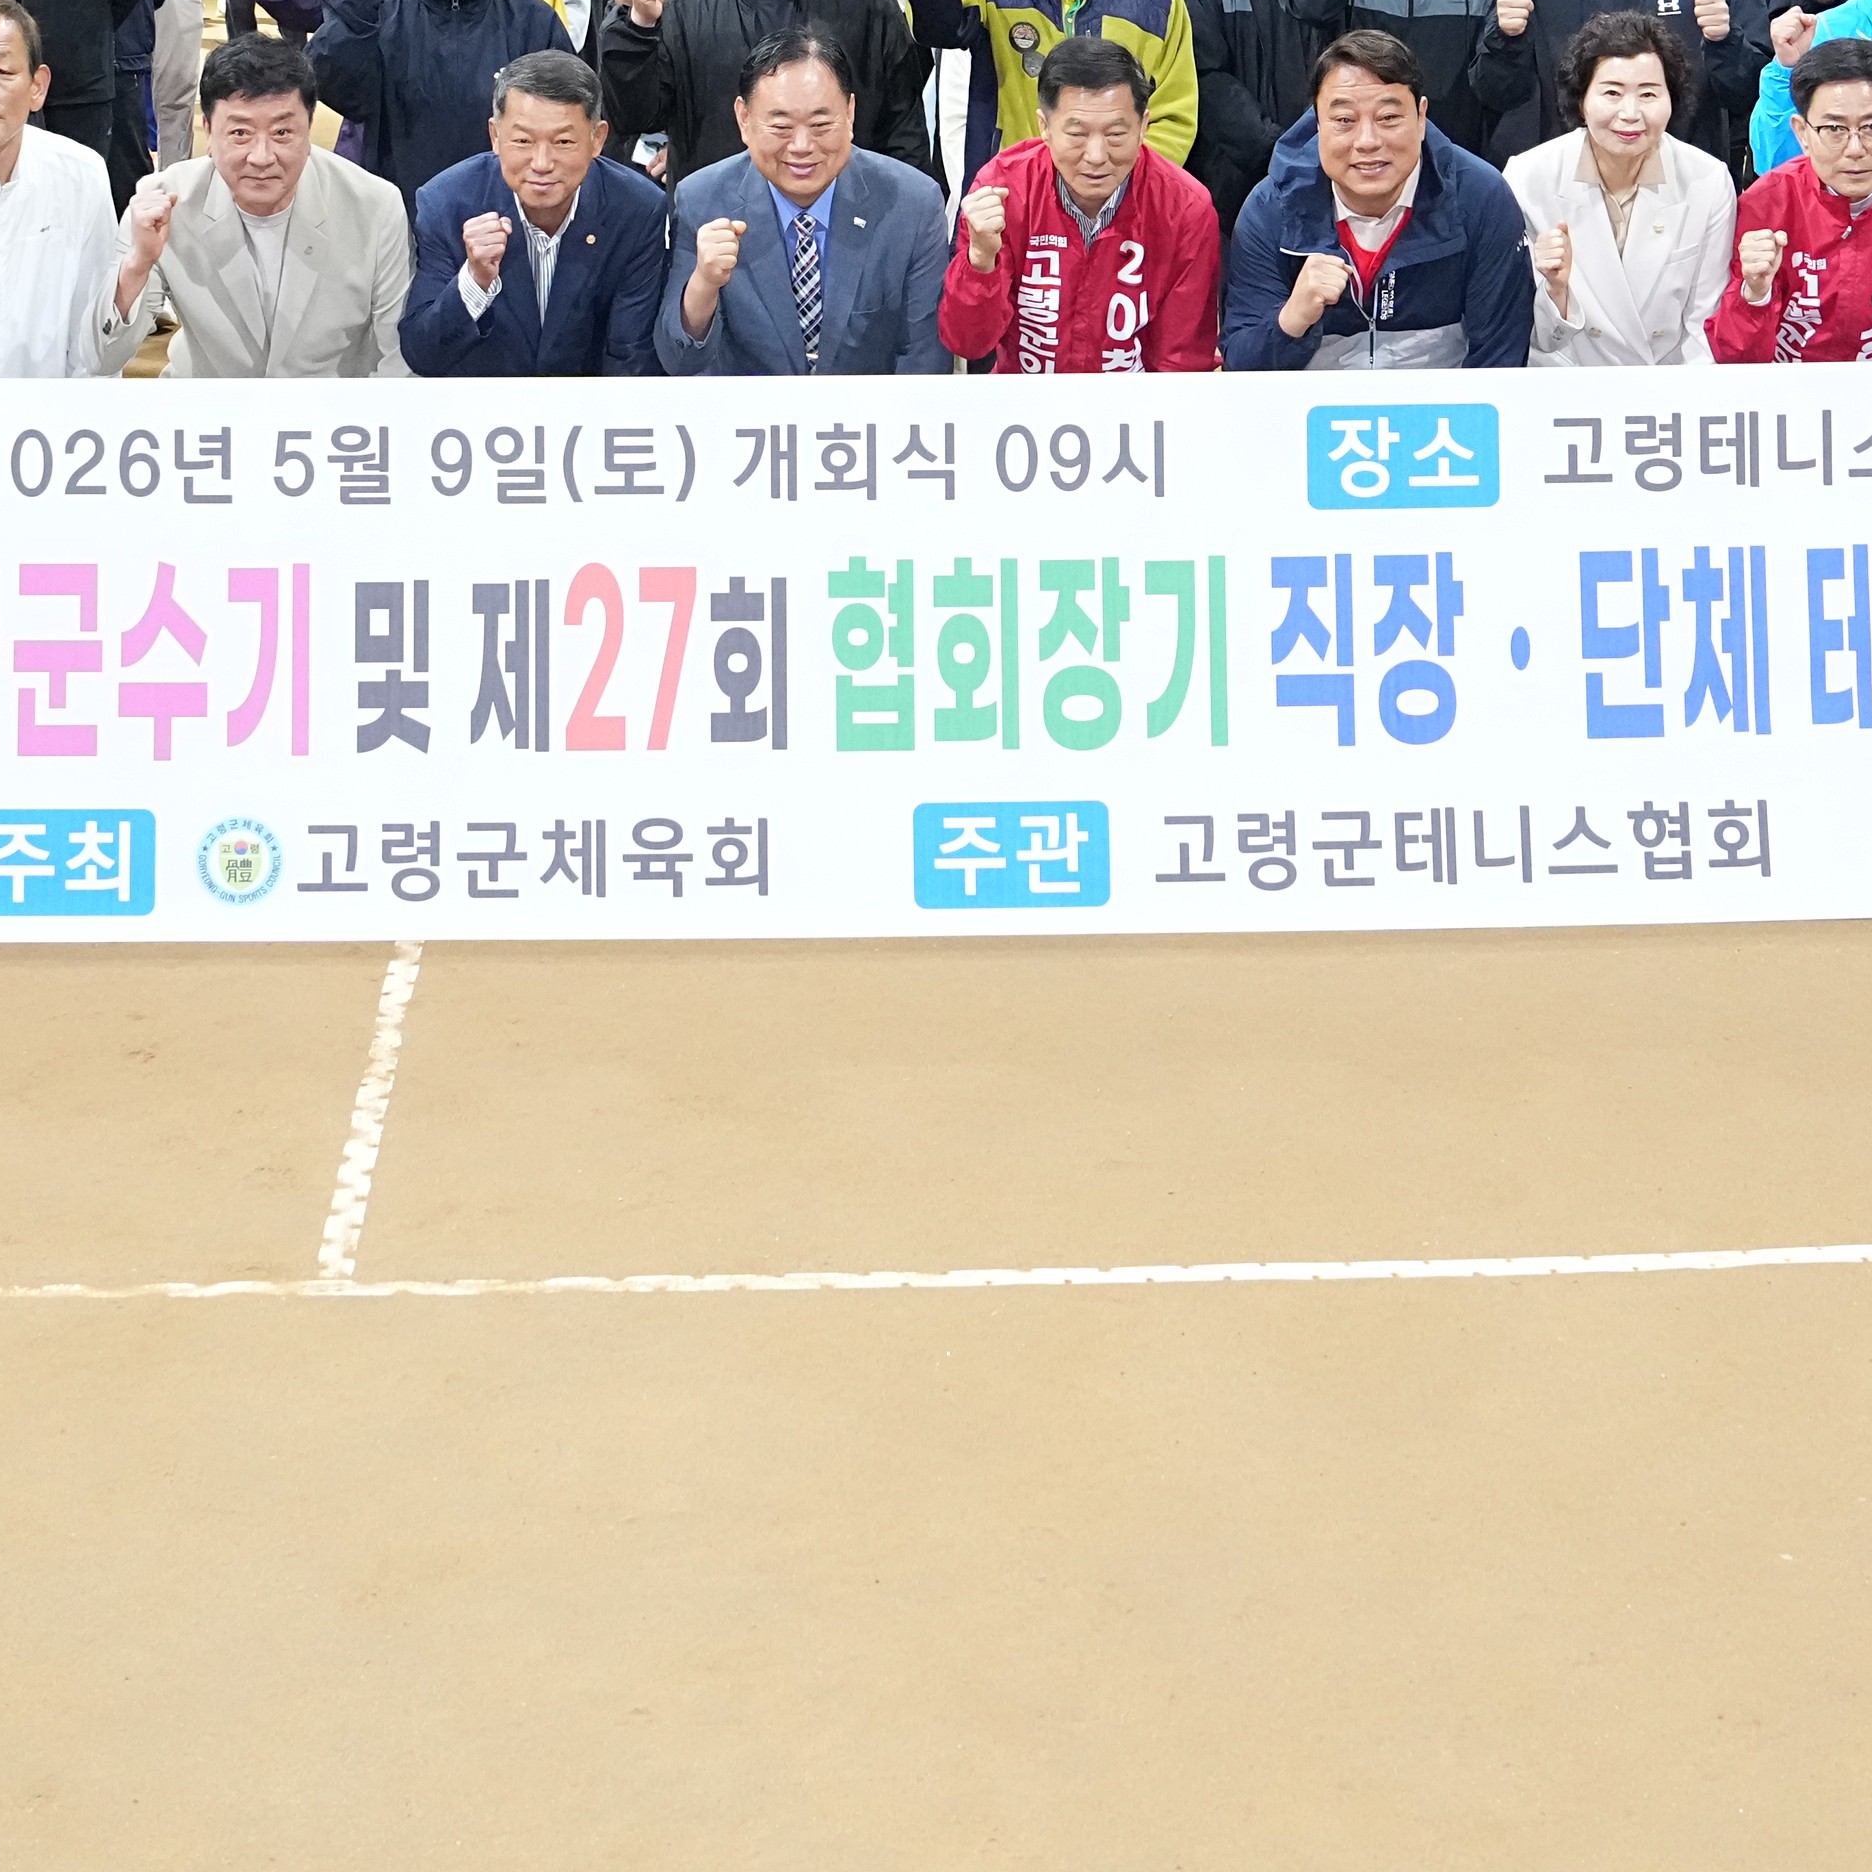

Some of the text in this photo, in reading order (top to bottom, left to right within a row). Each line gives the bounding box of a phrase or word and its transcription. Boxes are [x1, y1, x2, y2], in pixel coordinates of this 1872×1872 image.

[1029, 234, 1068, 248] 국민의힘
[1117, 240, 1145, 285] 2
[274, 425, 391, 505] 5월
[431, 425, 695, 504] 9일(토)
[733, 423, 955, 501] 개회식
[996, 421, 1164, 497] 09시
[1328, 417, 1479, 497] 장소
[355, 580, 431, 754] 및
[471, 563, 787, 752] 제27회
[828, 556, 1228, 751] 협회장기
[238, 885, 268, 904] SPORTS
[264, 854, 282, 888] COUNCIL
[297, 817, 768, 902] 고령군체육회
[934, 813, 1088, 895] 주관
[1156, 800, 1771, 891] 고령군테니스협회
